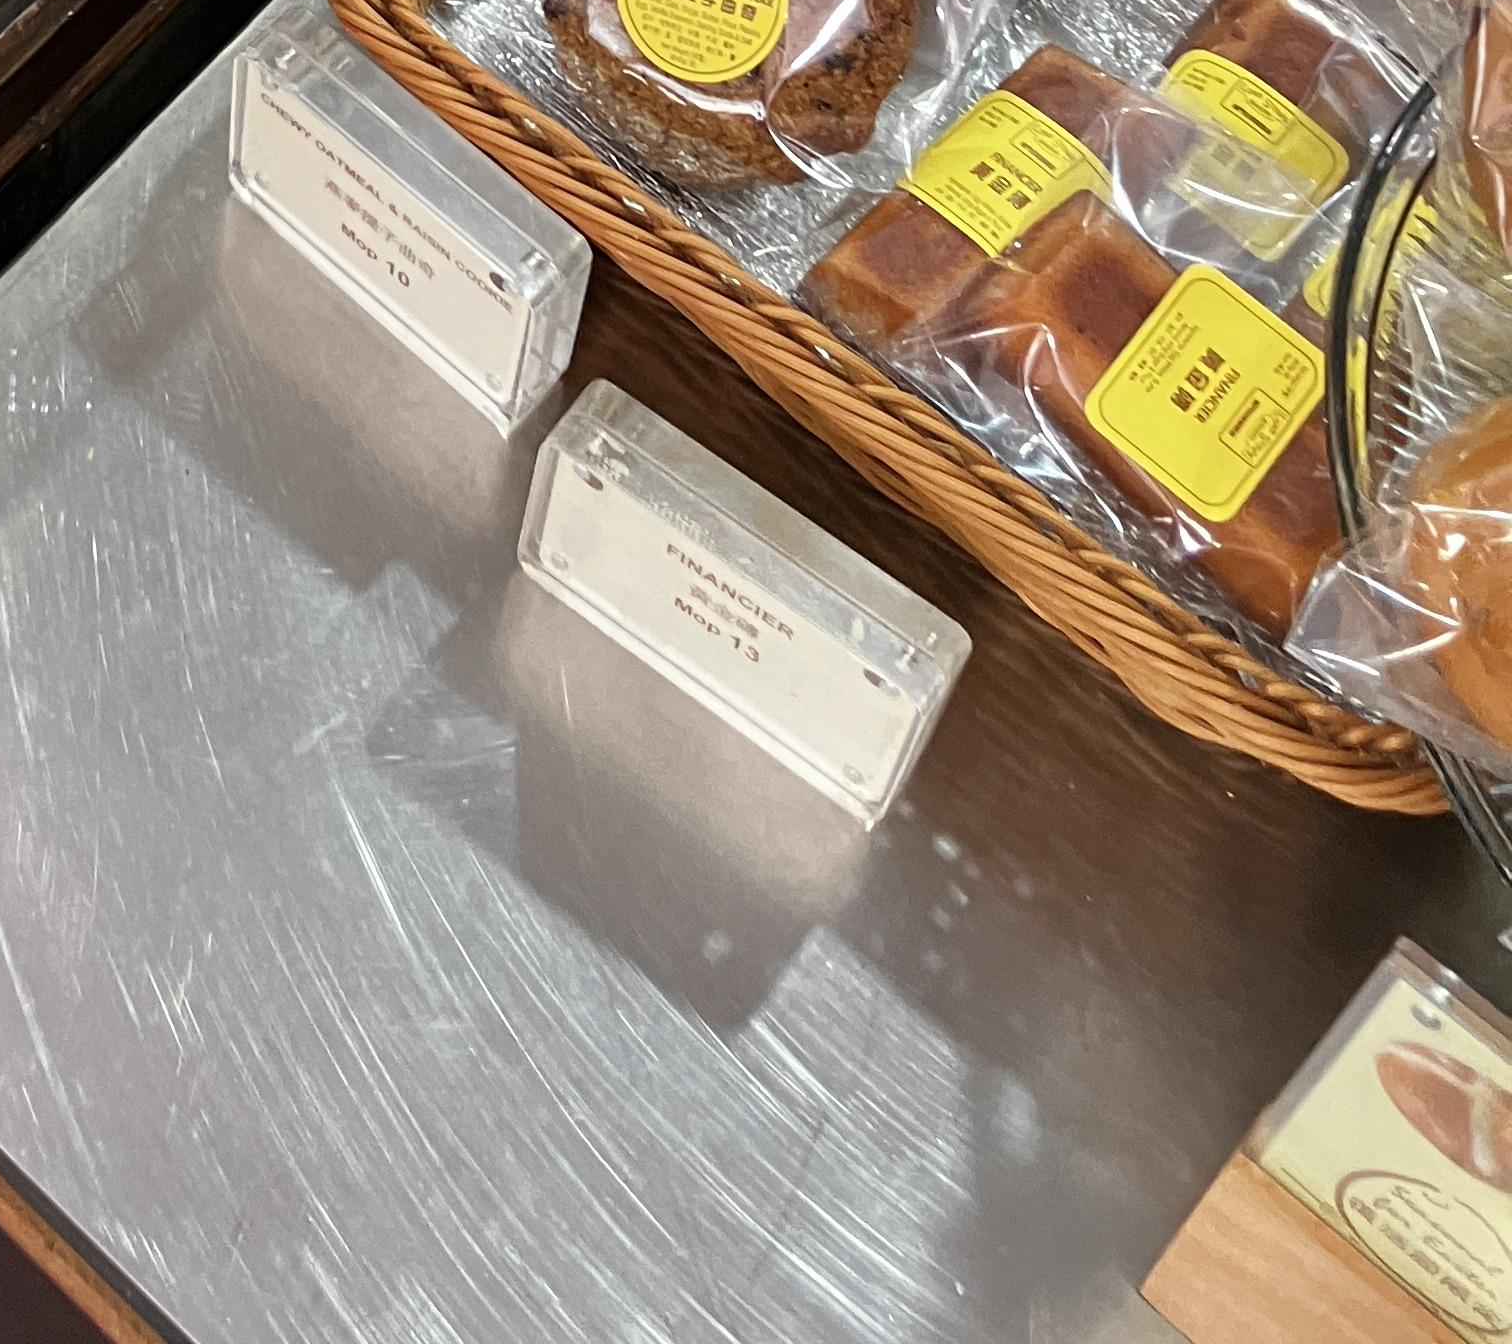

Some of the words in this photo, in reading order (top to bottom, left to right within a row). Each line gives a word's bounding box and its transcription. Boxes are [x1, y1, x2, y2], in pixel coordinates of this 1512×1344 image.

[261, 92, 312, 139] CHEWY
[315, 139, 384, 204] OATMEAL
[388, 203, 398, 216] &
[402, 214, 451, 262] RAISIN
[454, 259, 513, 315] COOKIE
[341, 222, 378, 261] Mop
[386, 261, 410, 288] 10
[1193, 367, 1241, 424] FINANCIER
[666, 543, 794, 641] FINANCIER
[674, 596, 721, 637] Mop
[728, 634, 760, 663] 13
